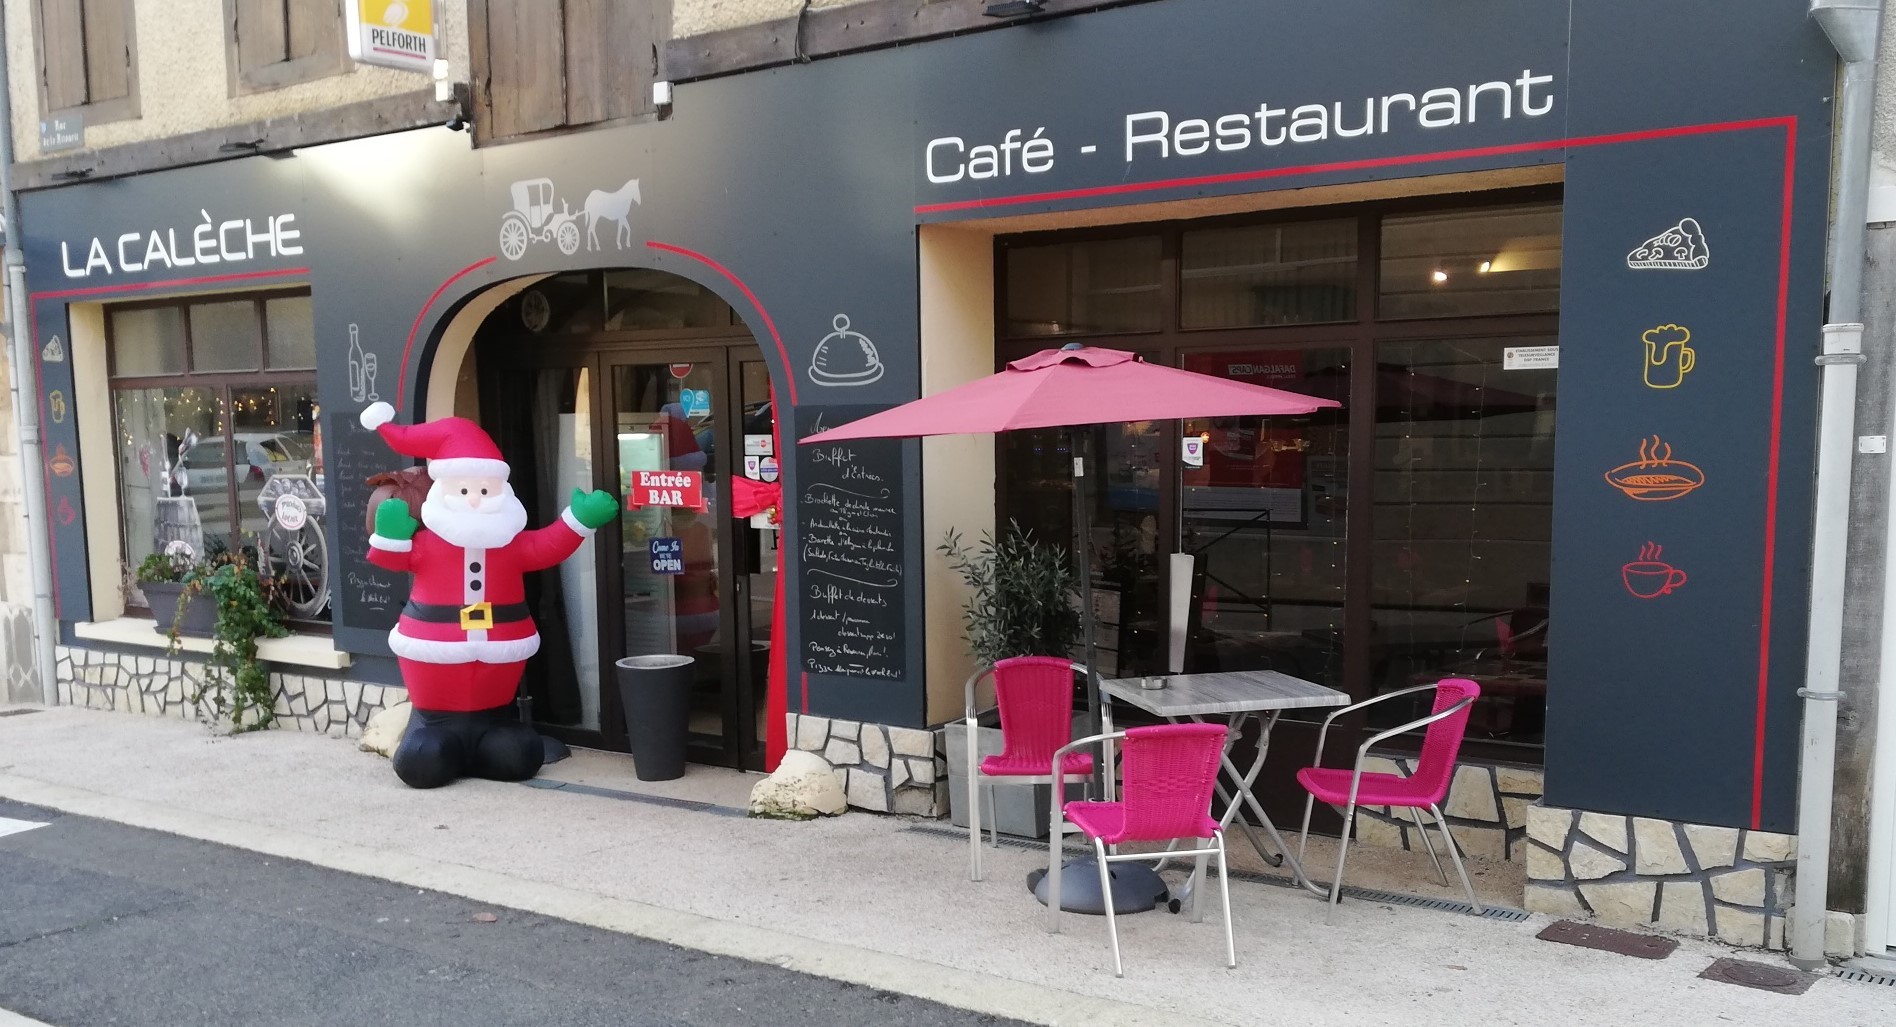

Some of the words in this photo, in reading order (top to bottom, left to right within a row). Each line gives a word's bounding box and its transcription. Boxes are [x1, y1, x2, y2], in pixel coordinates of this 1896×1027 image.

[371, 28, 426, 53] PELFORTH
[925, 127, 1055, 184] Café
[1125, 69, 1554, 163] Restaurant
[61, 237, 113, 278] LA
[117, 208, 304, 273] CALÈCHE
[640, 471, 692, 488] Entrée
[648, 489, 684, 506] BAR
[652, 540, 669, 554] Come
[652, 558, 682, 571] OPEN
[810, 583, 842, 604] Buffet
[807, 658, 834, 673] Pizza
